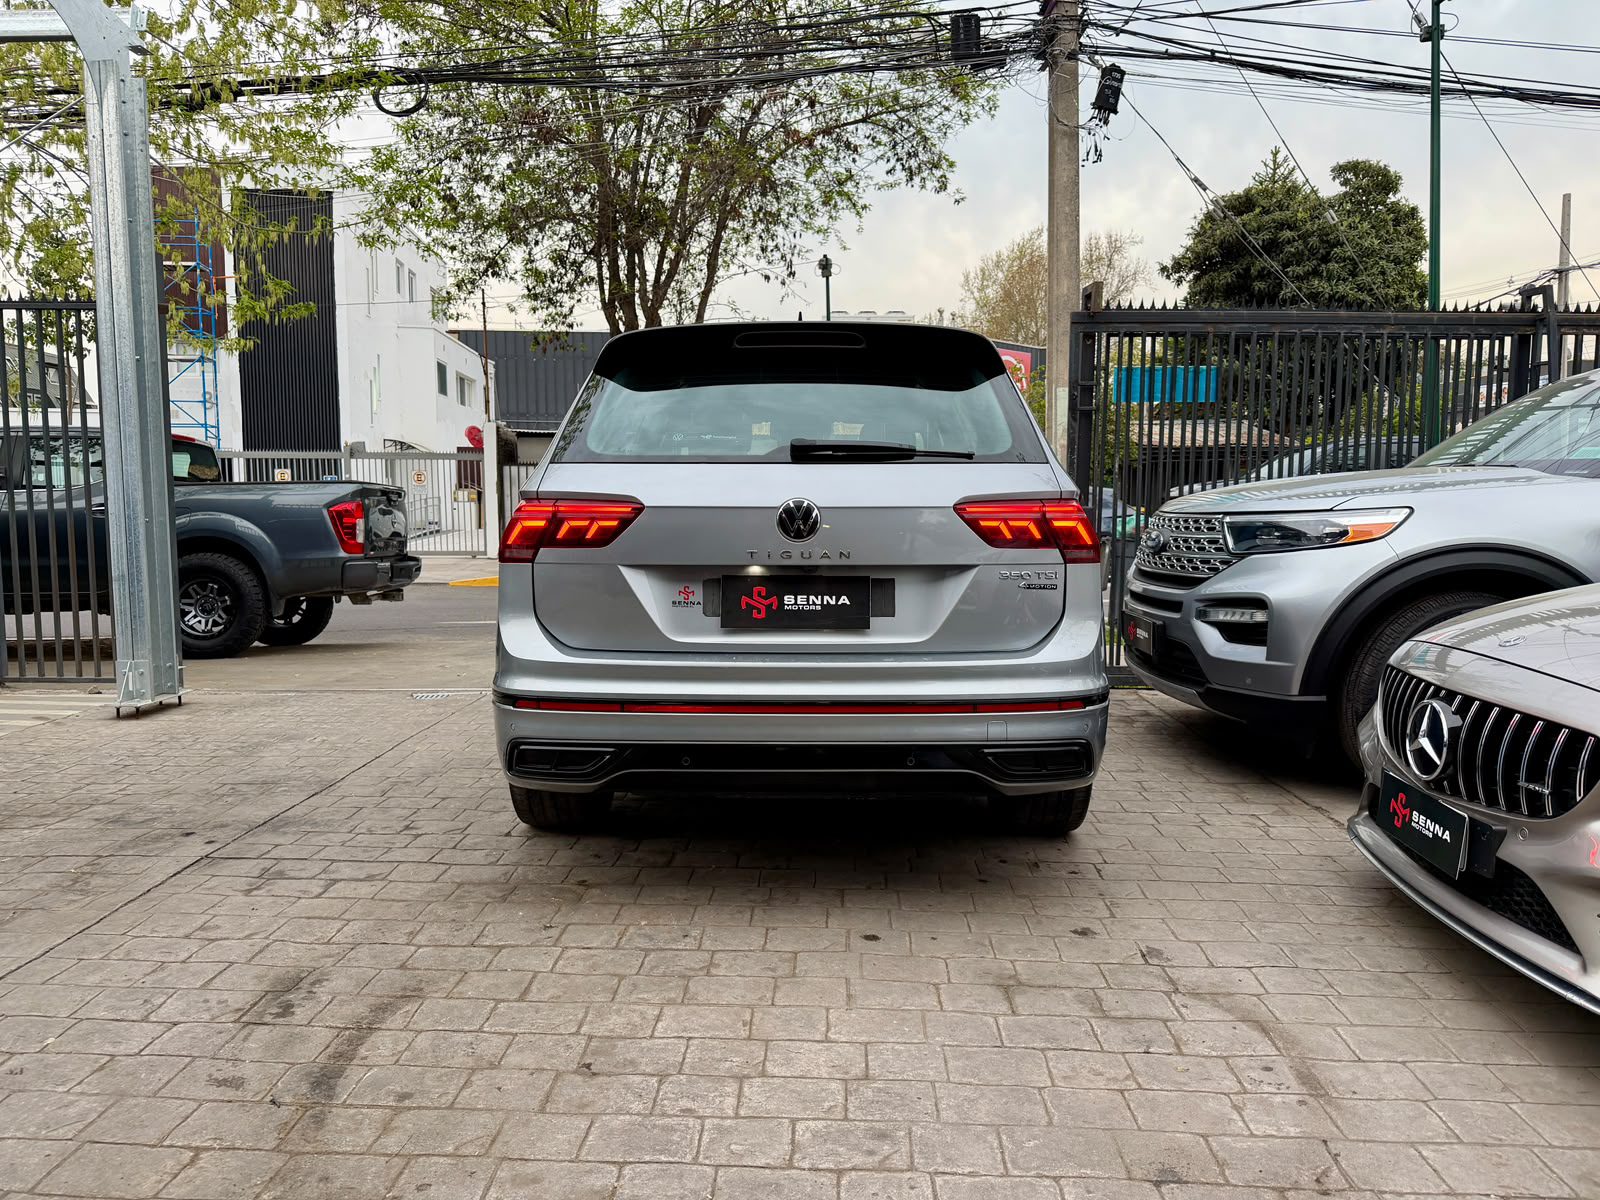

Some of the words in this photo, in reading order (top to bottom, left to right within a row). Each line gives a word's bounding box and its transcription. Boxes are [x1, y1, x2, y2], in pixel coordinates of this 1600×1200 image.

[999, 570, 1032, 580] 350
[783, 595, 851, 605] SENNA
[1411, 810, 1451, 843] SENNA
[1411, 821, 1433, 838] MOTORS
